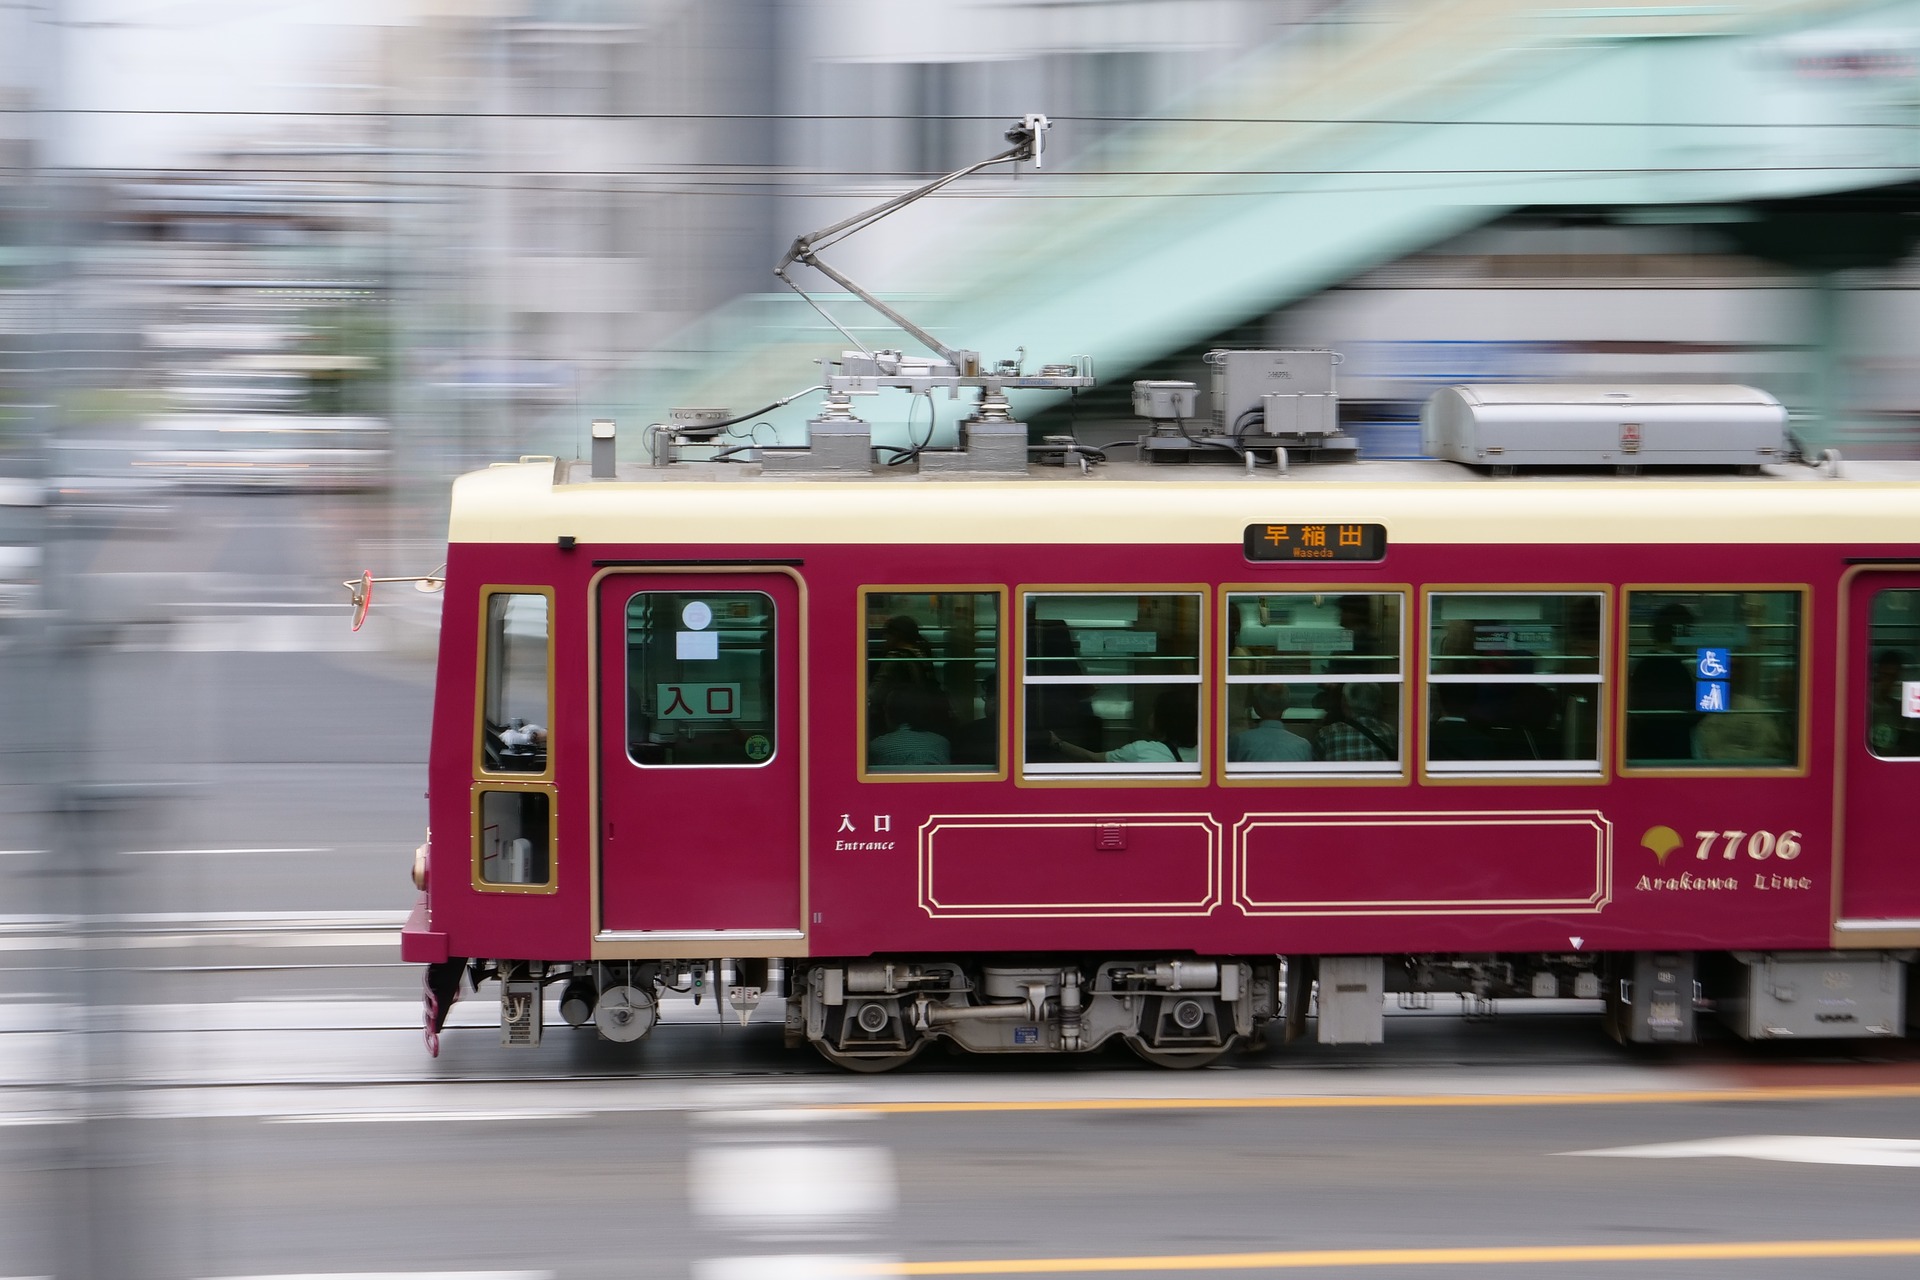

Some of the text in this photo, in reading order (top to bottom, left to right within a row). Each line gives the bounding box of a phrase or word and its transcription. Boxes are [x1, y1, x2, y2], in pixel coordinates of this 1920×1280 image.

[1264, 525, 1363, 546] 早稲田
[1293, 548, 1334, 558] Waseda
[664, 687, 733, 715] 入口
[837, 814, 891, 832] 入口
[835, 840, 895, 851] Entrance
[1695, 830, 1802, 860] 7706
[1635, 871, 1812, 891] Arakawa Line
